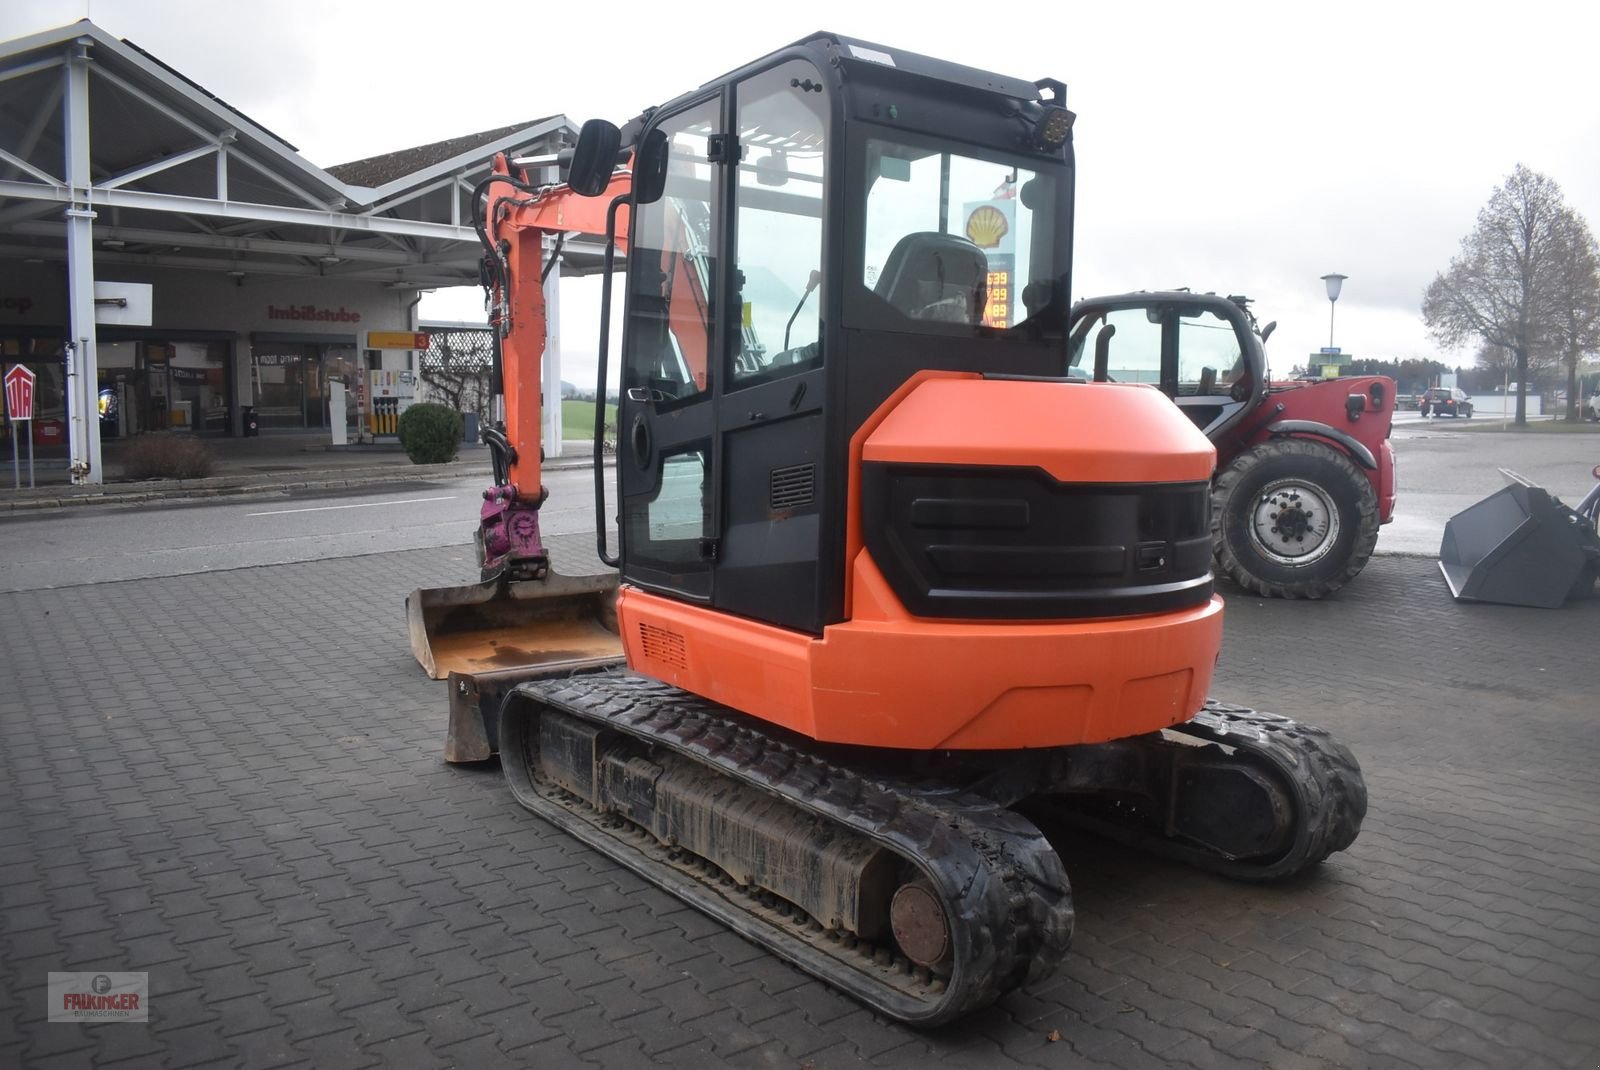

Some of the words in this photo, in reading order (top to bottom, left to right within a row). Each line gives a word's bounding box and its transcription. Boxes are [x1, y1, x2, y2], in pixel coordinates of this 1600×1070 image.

[268, 304, 361, 322] Imbißstube
[418, 335, 427, 347] 3
[6, 367, 33, 418] UTA
